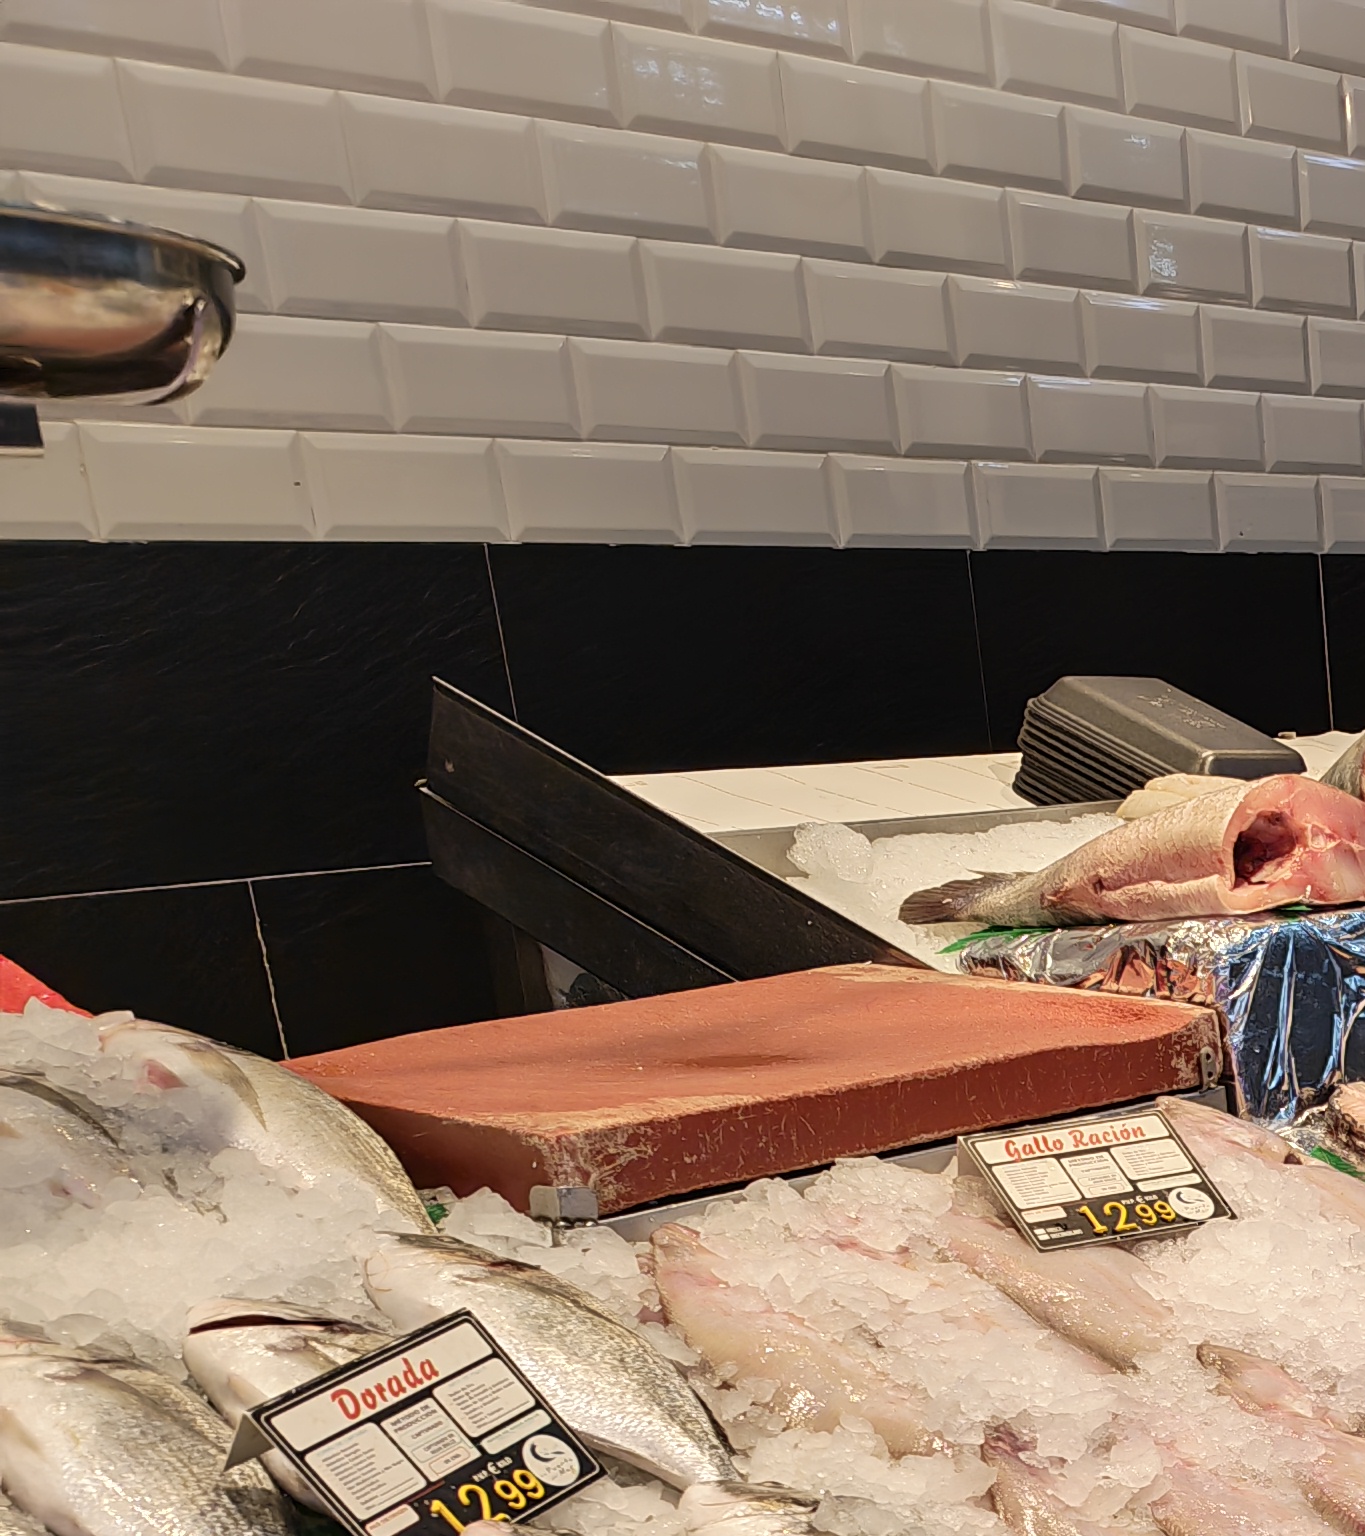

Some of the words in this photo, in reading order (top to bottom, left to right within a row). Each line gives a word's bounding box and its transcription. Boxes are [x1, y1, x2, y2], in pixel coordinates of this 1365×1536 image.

[1004, 1136, 1065, 1163] Gallo
[1072, 1122, 1147, 1150] Ración
[330, 1355, 440, 1421] Dorada
